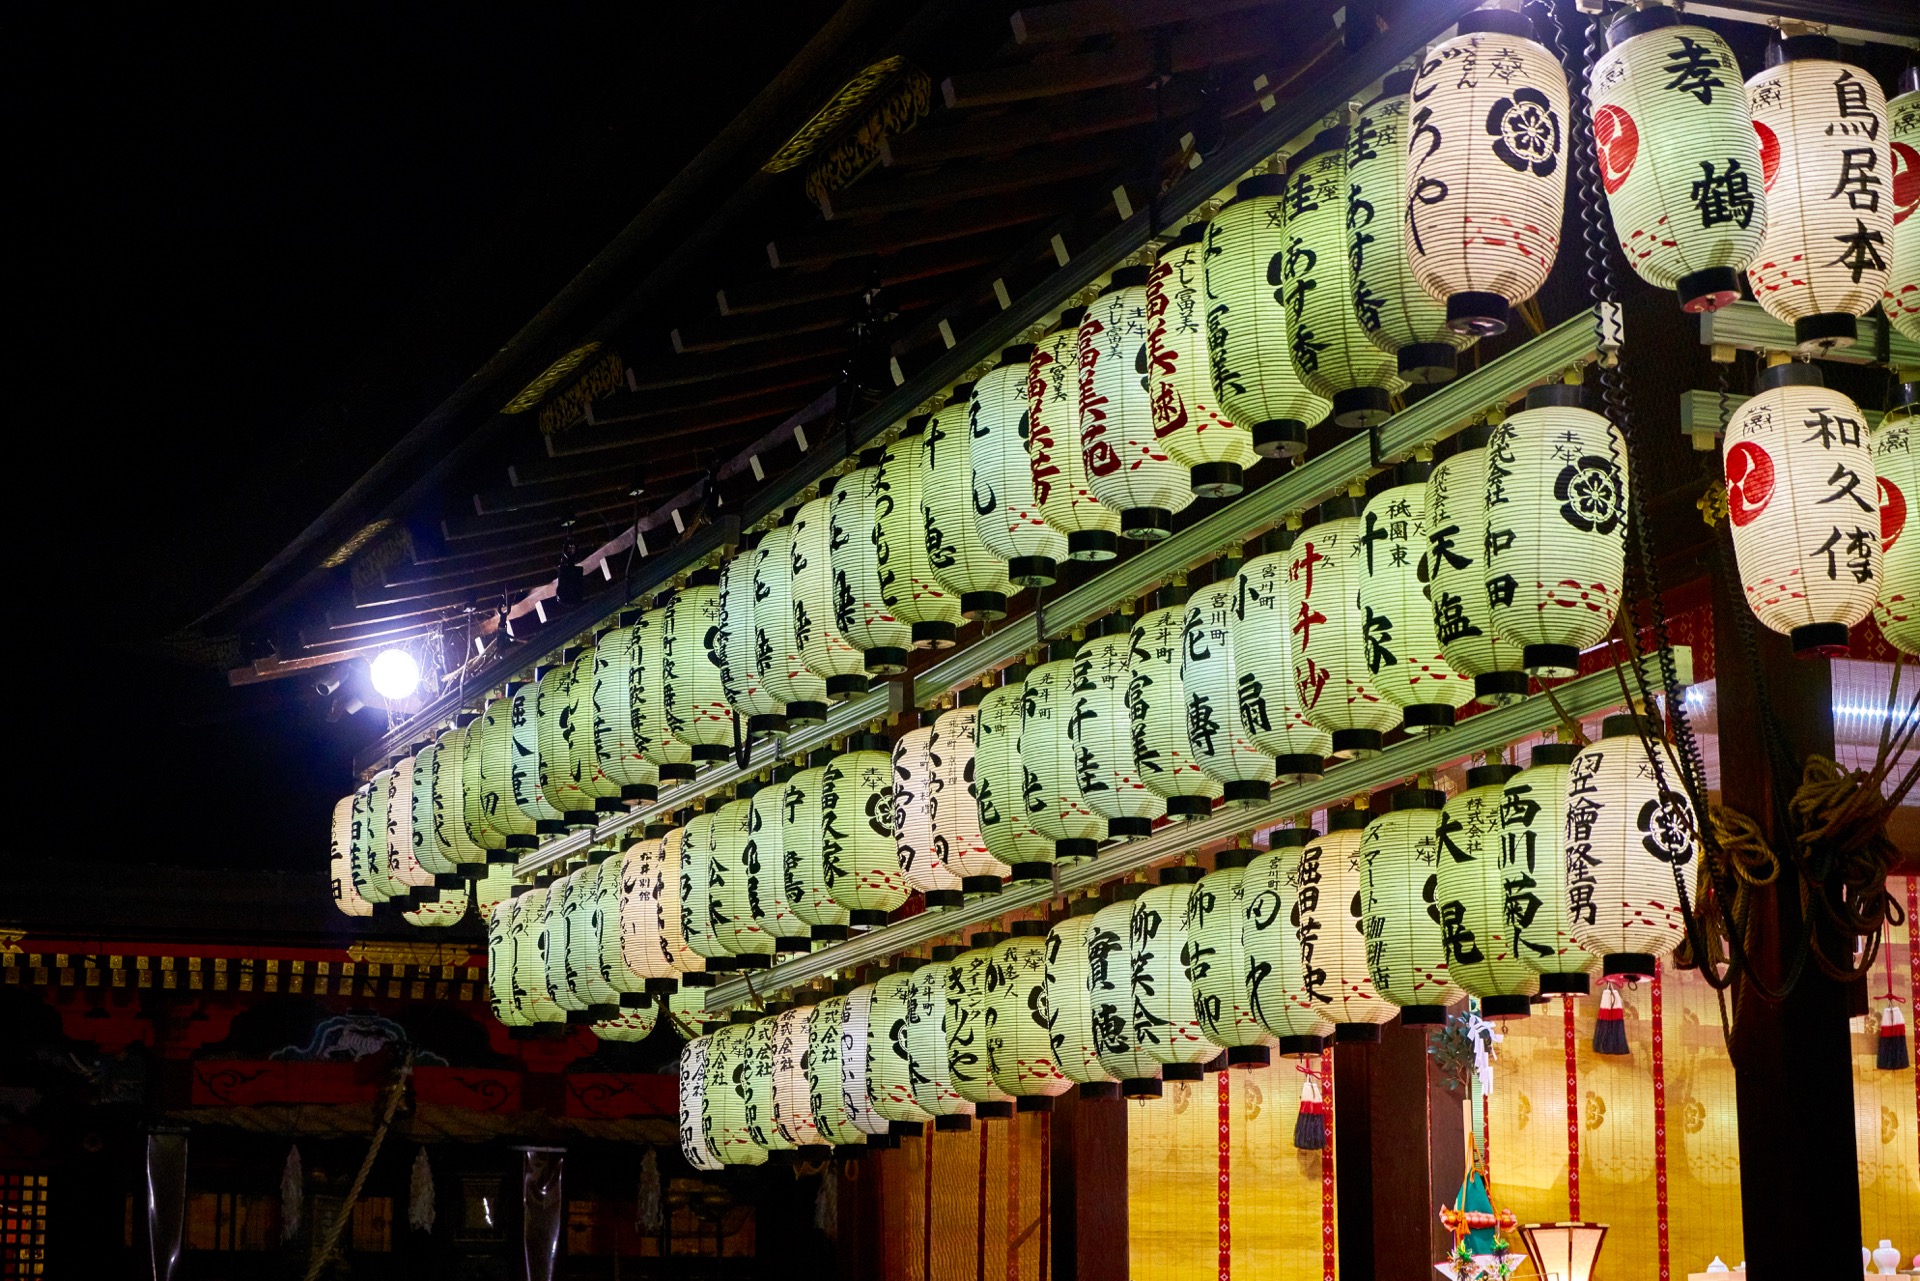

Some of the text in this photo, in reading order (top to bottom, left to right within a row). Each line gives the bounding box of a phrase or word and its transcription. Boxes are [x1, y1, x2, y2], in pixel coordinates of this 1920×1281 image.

[1376, 100, 1407, 147] 銀座
[1663, 36, 1755, 230] 孝鶴
[1314, 154, 1343, 204] 銀座
[1821, 68, 1887, 285] 鳥居本
[1174, 248, 1199, 335] よし富美
[1105, 295, 1128, 362] よし富美
[1483, 421, 1519, 610] 株式会社 和田
[1801, 406, 1877, 586] 和久傳
[1386, 499, 1412, 567] 祇園東
[1426, 464, 1483, 647] 株式会社 天塩
[1259, 562, 1277, 611] 宮川町
[1154, 611, 1177, 664] 先斗町
[1210, 592, 1229, 646] 宮川町
[1286, 541, 1331, 710] 叶千沙
[1100, 642, 1119, 690] 先斗町
[1230, 572, 1272, 736] 小扇
[994, 695, 1009, 737] 先斗町
[1037, 672, 1054, 720] 先斗町
[1466, 798, 1487, 855] 株式会社
[1565, 752, 1606, 926] 翌檜隆男
[639, 851, 654, 902] 松井別館
[1266, 856, 1281, 892] 宮川町
[1436, 811, 1486, 966] 大晃
[923, 973, 936, 1018] 先斗町
[778, 1010, 798, 1070] 株式会社
[822, 999, 843, 1065] 株式会社
